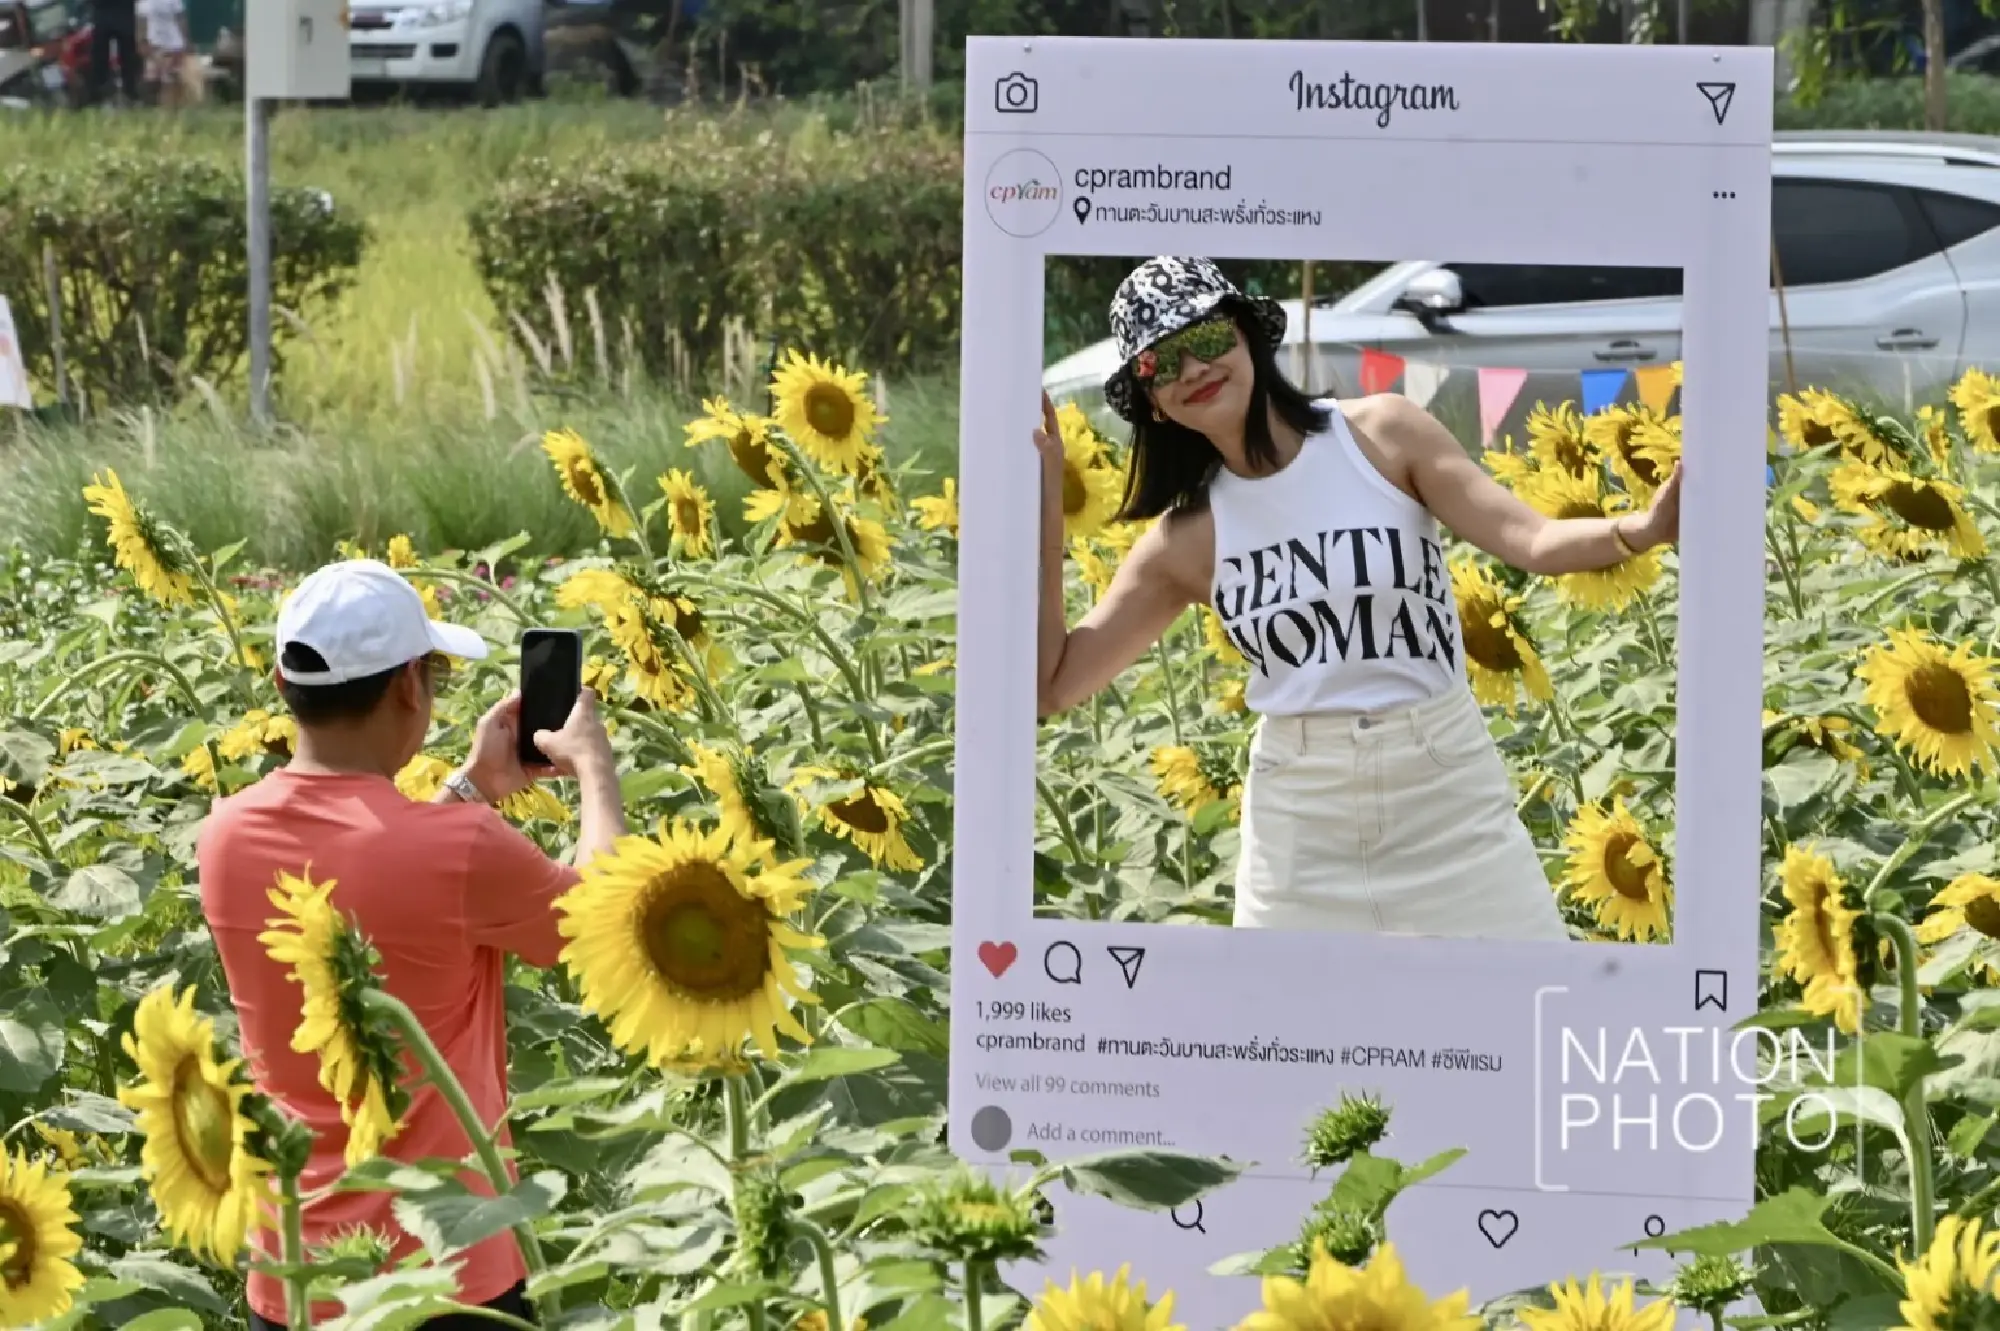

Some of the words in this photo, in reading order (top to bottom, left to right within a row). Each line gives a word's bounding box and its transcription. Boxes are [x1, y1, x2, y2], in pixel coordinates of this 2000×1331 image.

[1288, 69, 1460, 129] Instagram
[1074, 164, 1232, 192] cprambrand
[1215, 526, 1445, 622] GENTLE
[1222, 592, 1456, 679] WOMAN
[976, 1000, 1025, 1022] 1,999
[1030, 1001, 1072, 1023] likes
[975, 1031, 1086, 1053] cprambrand
[1340, 1045, 1427, 1068] #CPRAM
[975, 1072, 1017, 1091] View
[1020, 1074, 1041, 1093] all
[1044, 1076, 1066, 1094] 99
[1069, 1080, 1160, 1098] comments
[1026, 1122, 1063, 1141] Add
[1066, 1129, 1077, 1142] a
[1079, 1128, 1177, 1147] comment...
